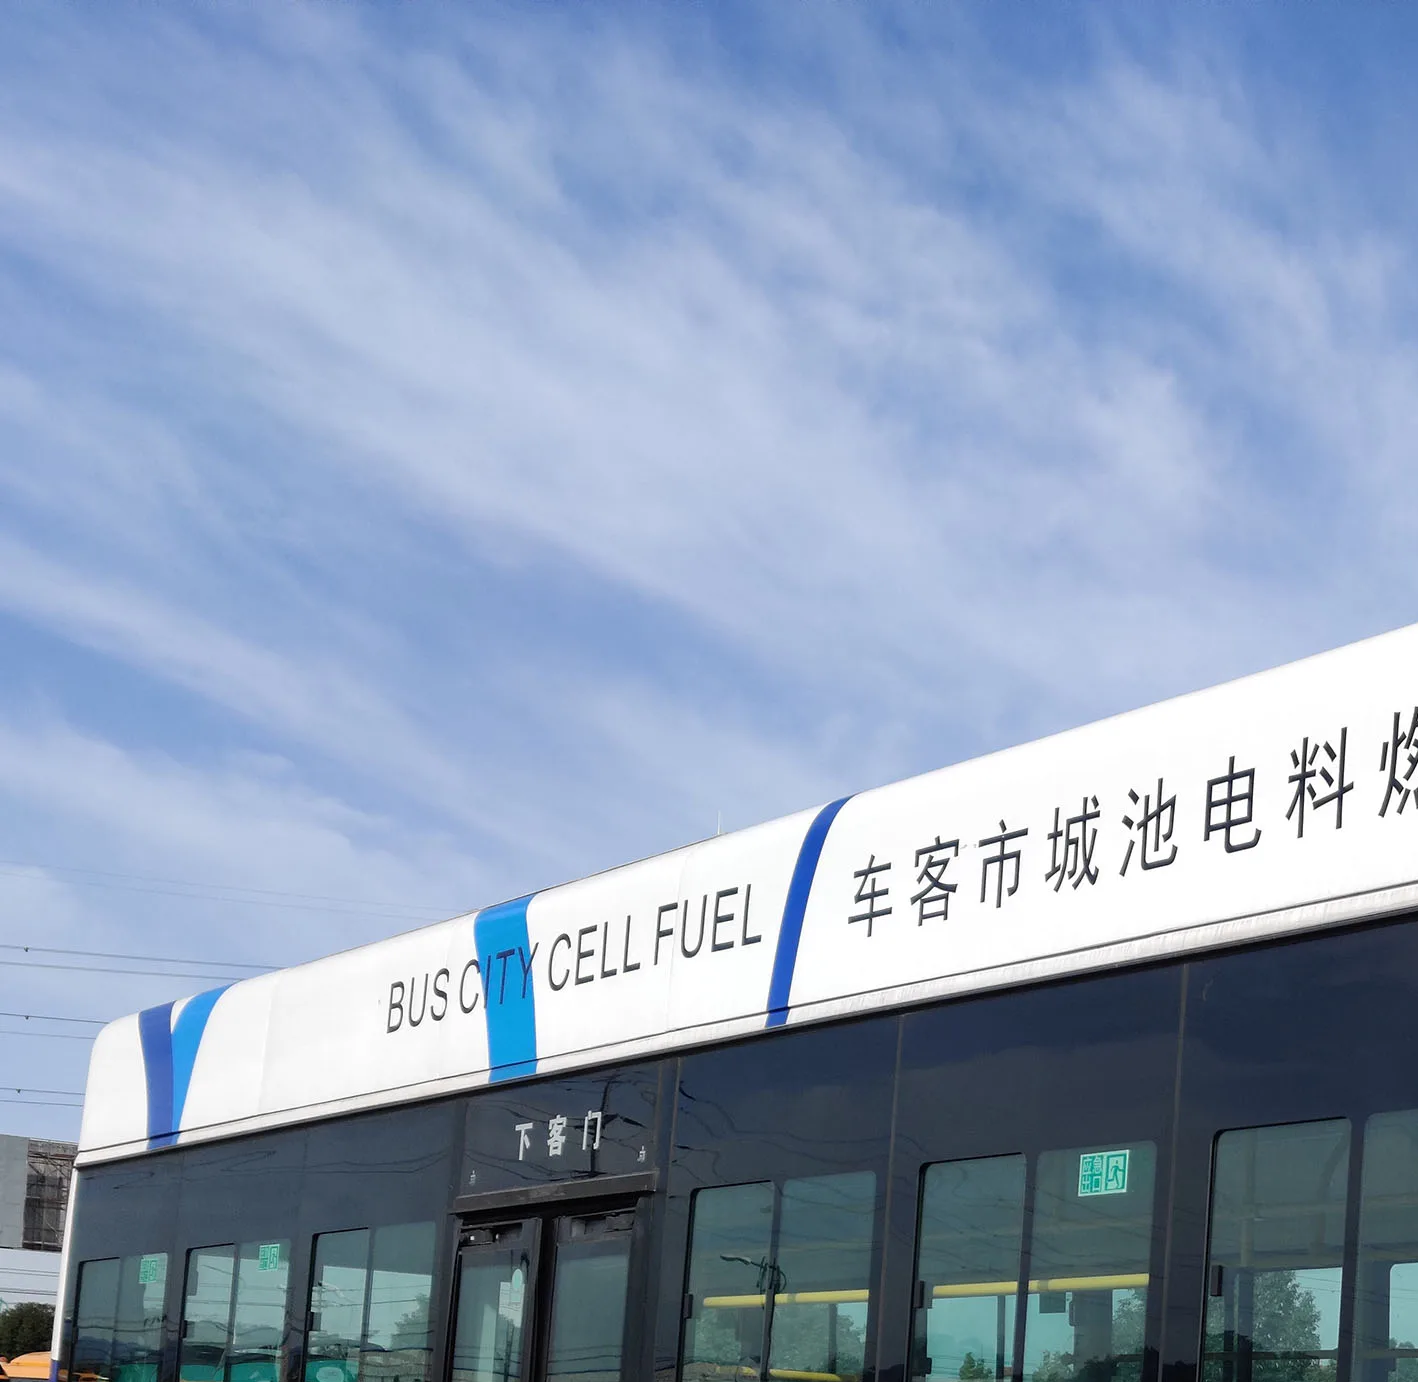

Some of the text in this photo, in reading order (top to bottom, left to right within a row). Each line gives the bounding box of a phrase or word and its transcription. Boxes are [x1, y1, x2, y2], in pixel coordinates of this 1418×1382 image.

[386, 884, 762, 1034] BUS CITY CELL FUEL
[515, 1109, 603, 1161] 下客门
